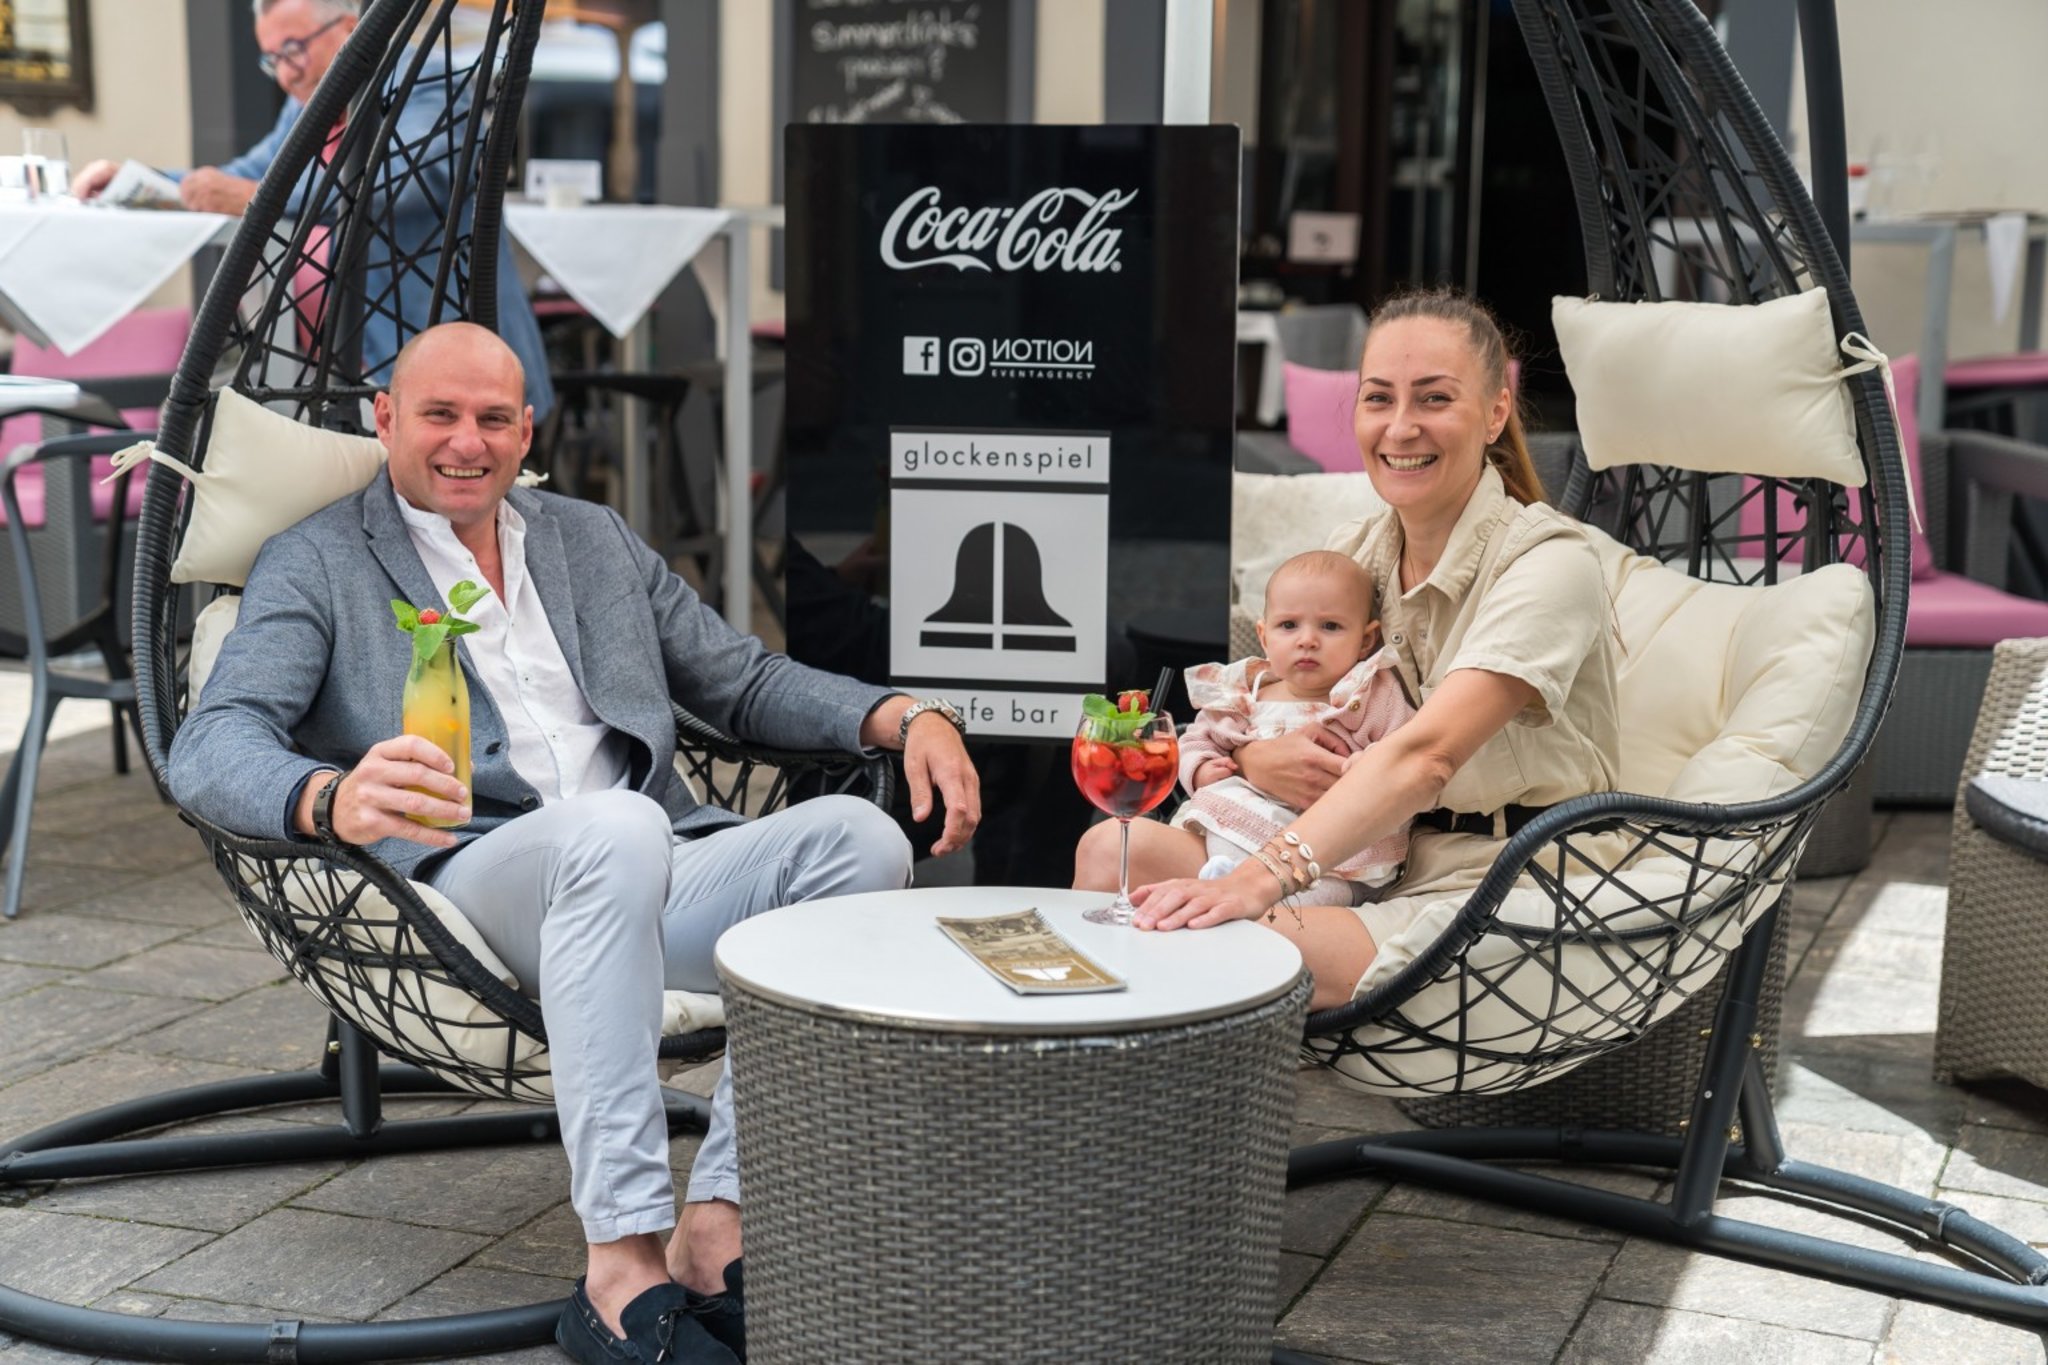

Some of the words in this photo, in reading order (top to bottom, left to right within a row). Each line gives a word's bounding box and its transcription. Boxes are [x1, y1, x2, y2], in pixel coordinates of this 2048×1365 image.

[880, 186, 1139, 273] Coca-Cola
[991, 369, 1092, 379] EVENTAGENCY
[904, 441, 1091, 474] glockenspiel
[1011, 699, 1058, 723] bar
